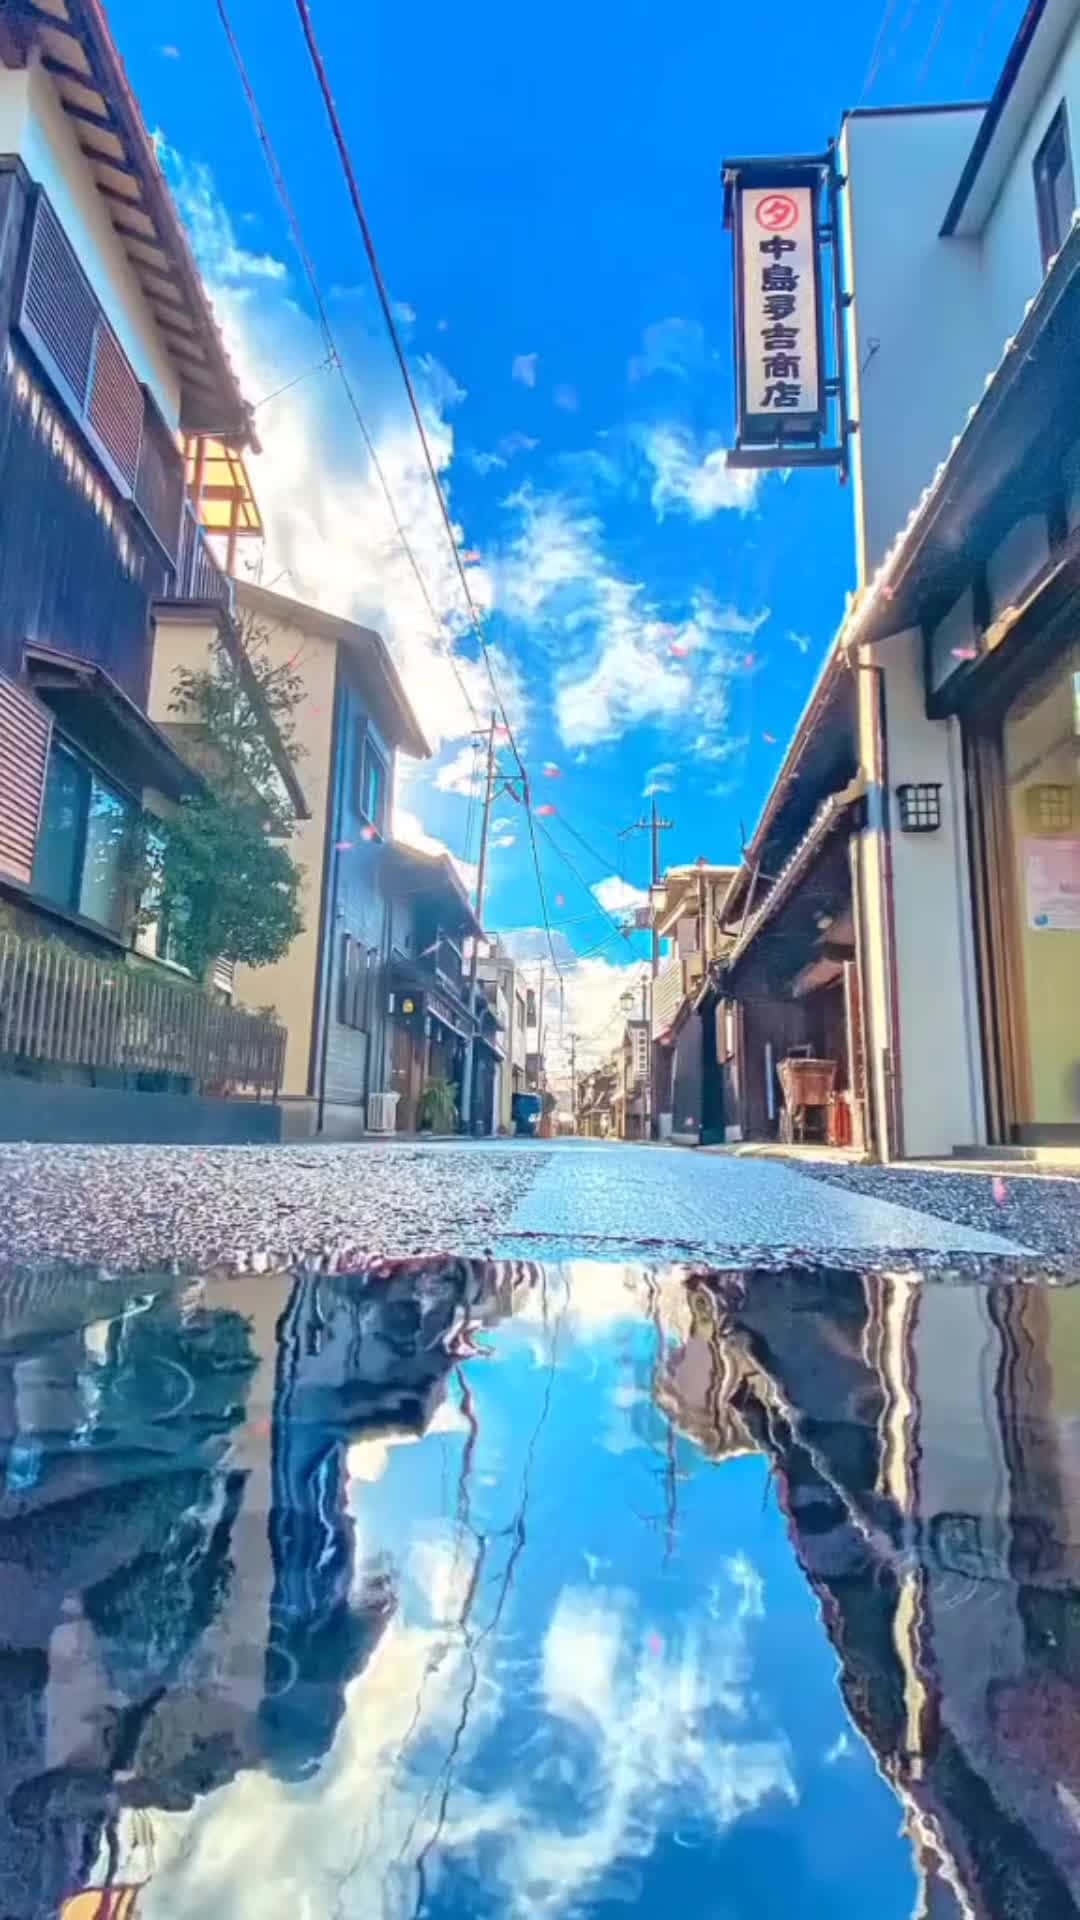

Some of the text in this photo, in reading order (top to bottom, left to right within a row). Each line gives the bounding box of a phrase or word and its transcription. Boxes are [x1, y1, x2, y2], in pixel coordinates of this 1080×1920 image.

[759, 235, 801, 408] 中島多吉商店
